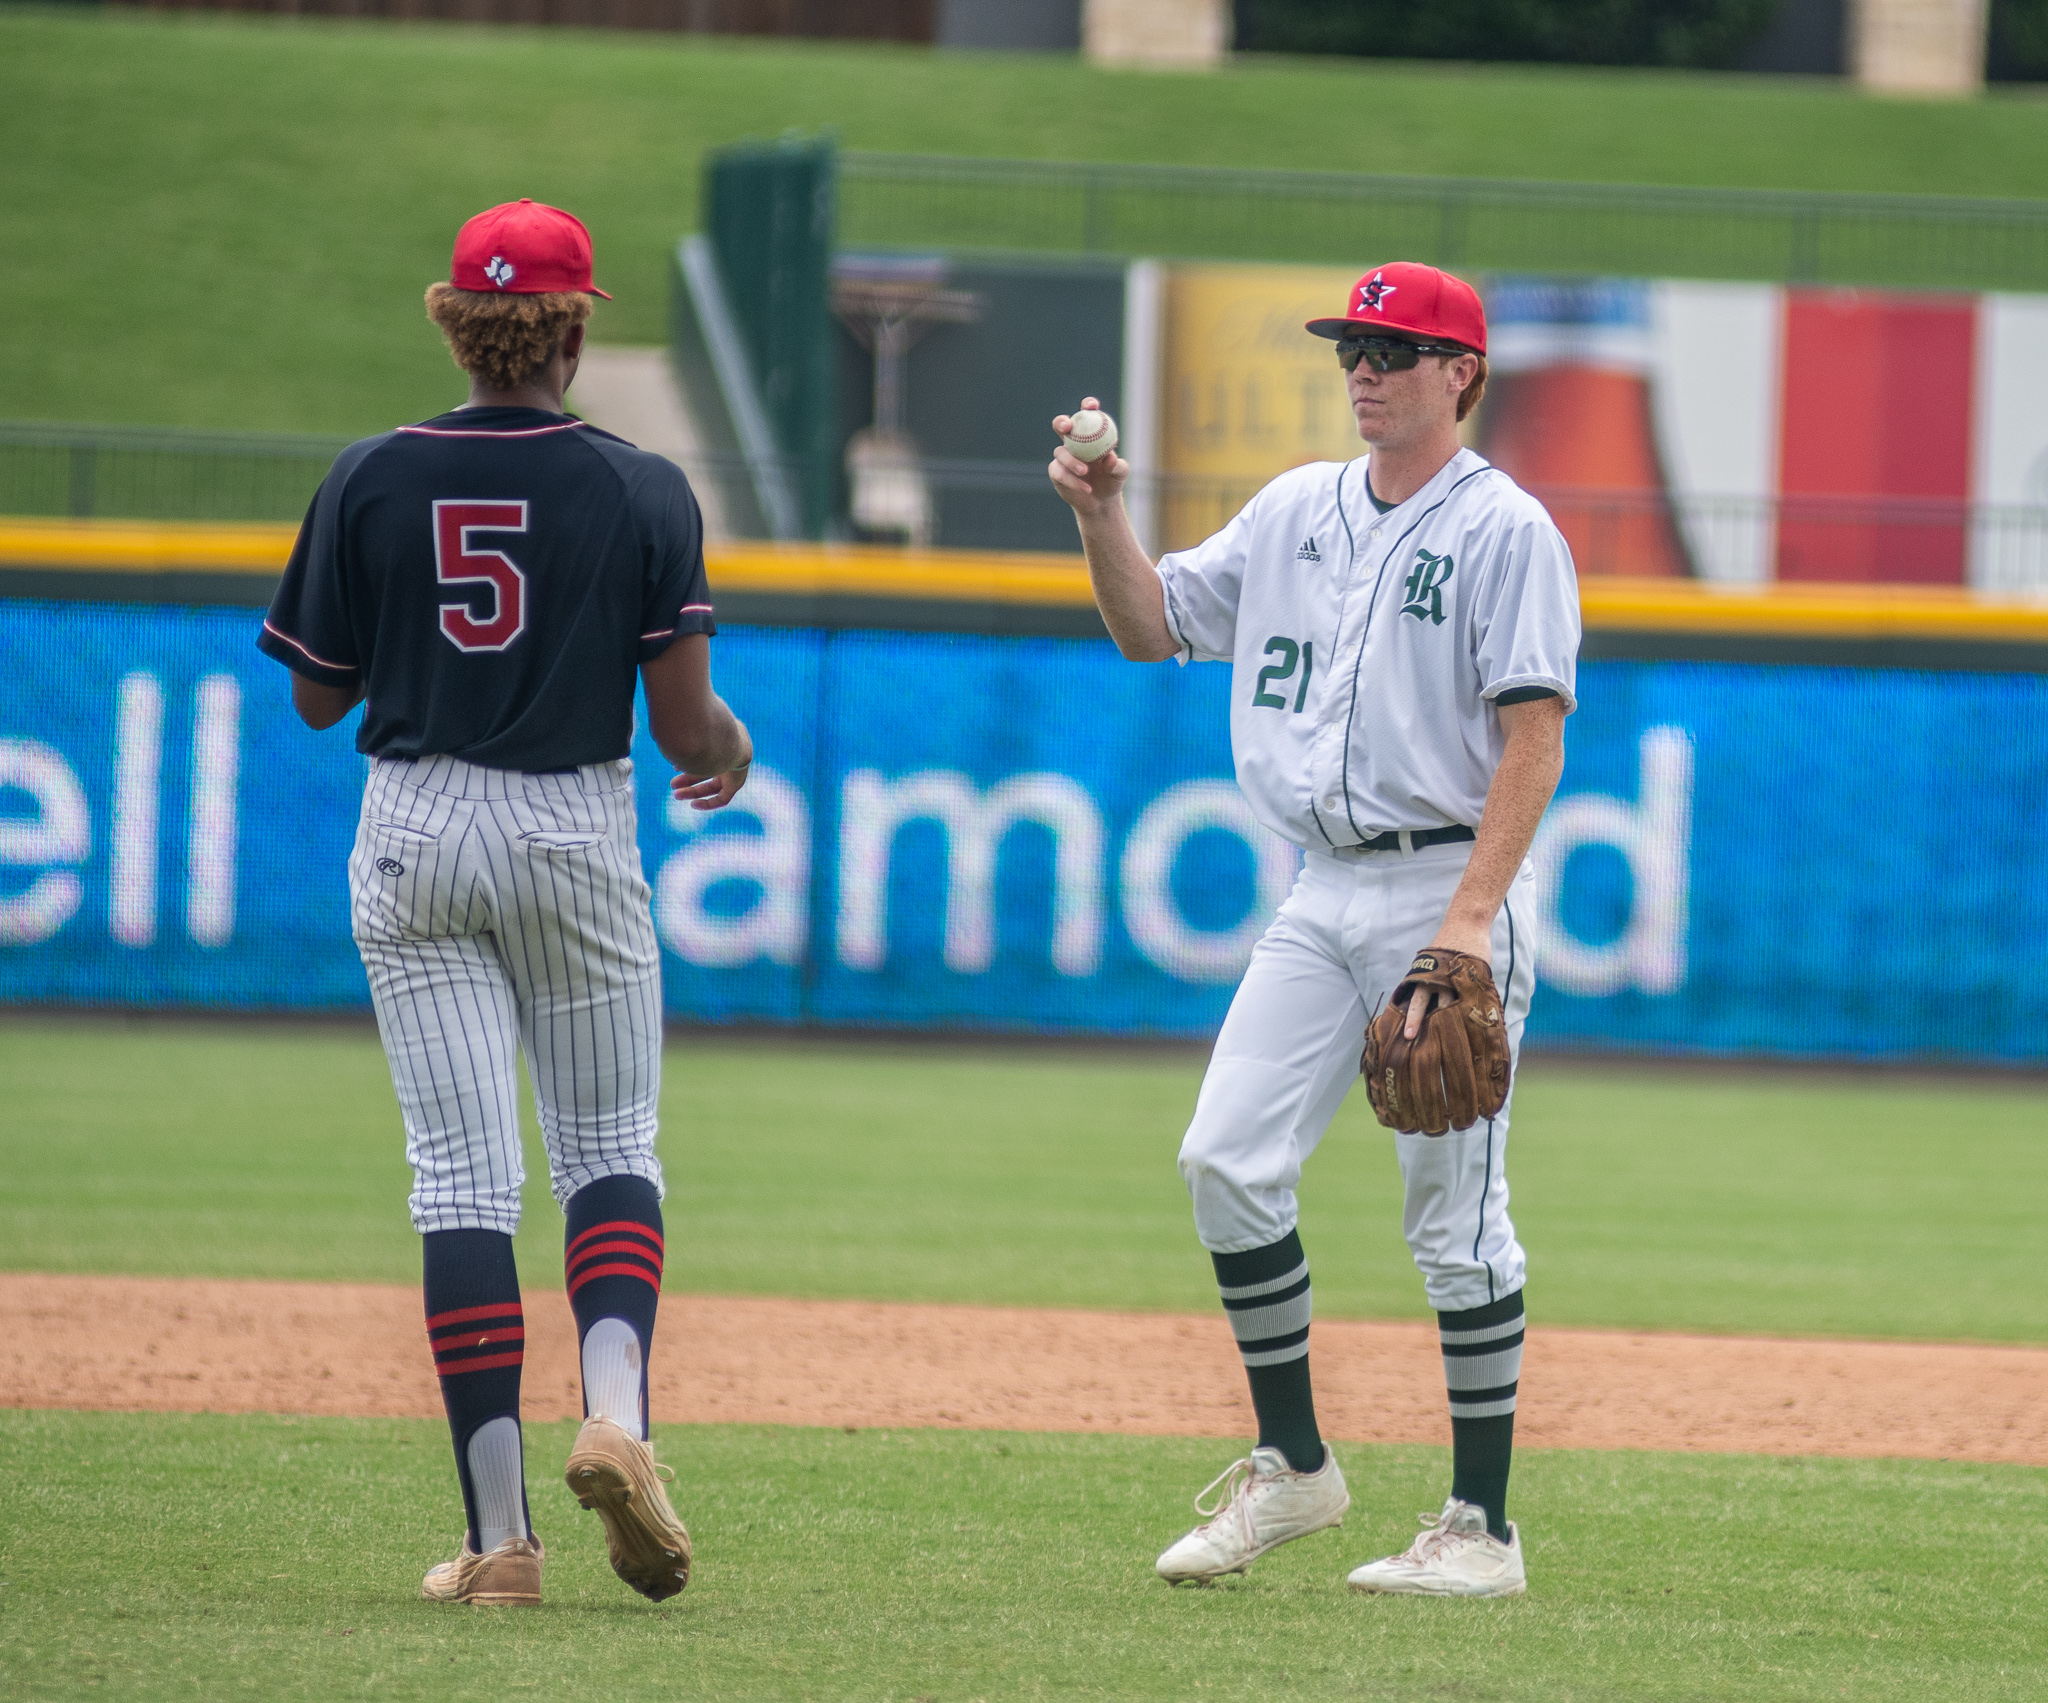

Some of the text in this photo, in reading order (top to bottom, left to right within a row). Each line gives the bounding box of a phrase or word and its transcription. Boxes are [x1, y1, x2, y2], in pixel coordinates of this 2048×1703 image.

[432, 500, 528, 652] 5
[1296, 550, 1321, 562] adidas
[1399, 548, 1454, 626] R
[1252, 635, 1313, 714] 21
